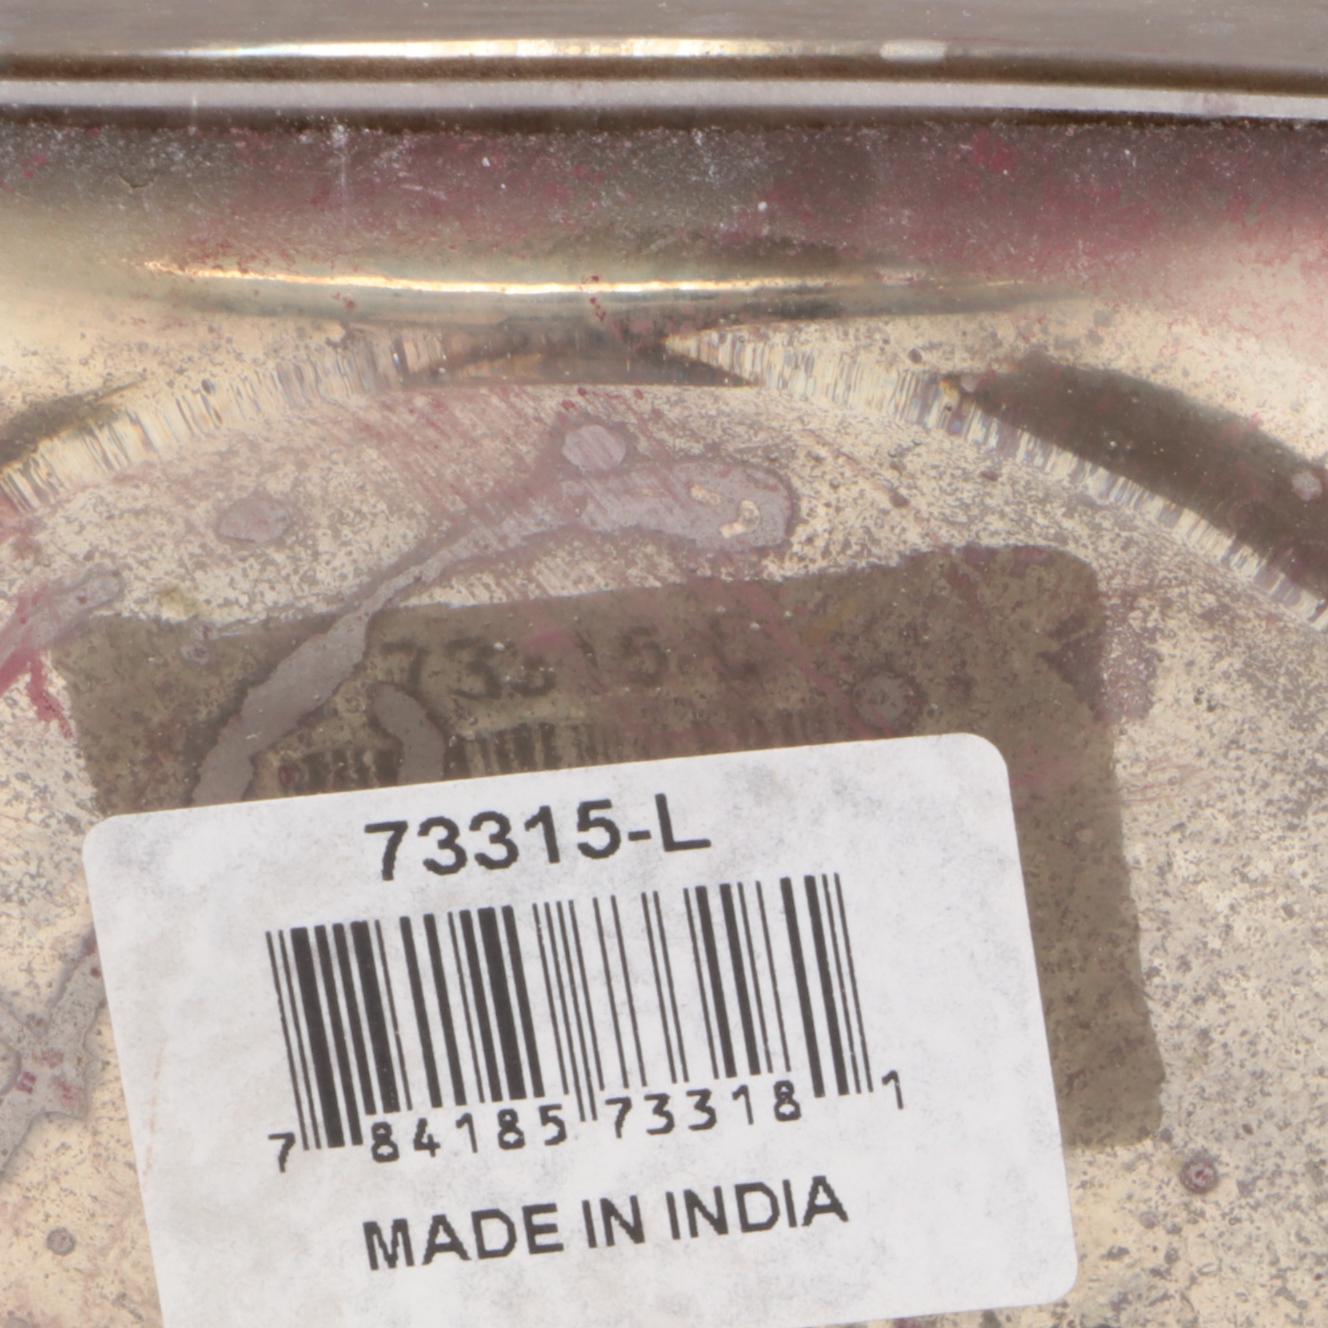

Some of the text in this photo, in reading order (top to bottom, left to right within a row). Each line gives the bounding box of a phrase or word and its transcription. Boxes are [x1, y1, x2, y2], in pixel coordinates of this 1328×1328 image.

[364, 793, 712, 881] 73315-L
[268, 1070, 903, 1173] 7 84185 73318 1
[363, 1175, 849, 1271] MADE IN INDIA
